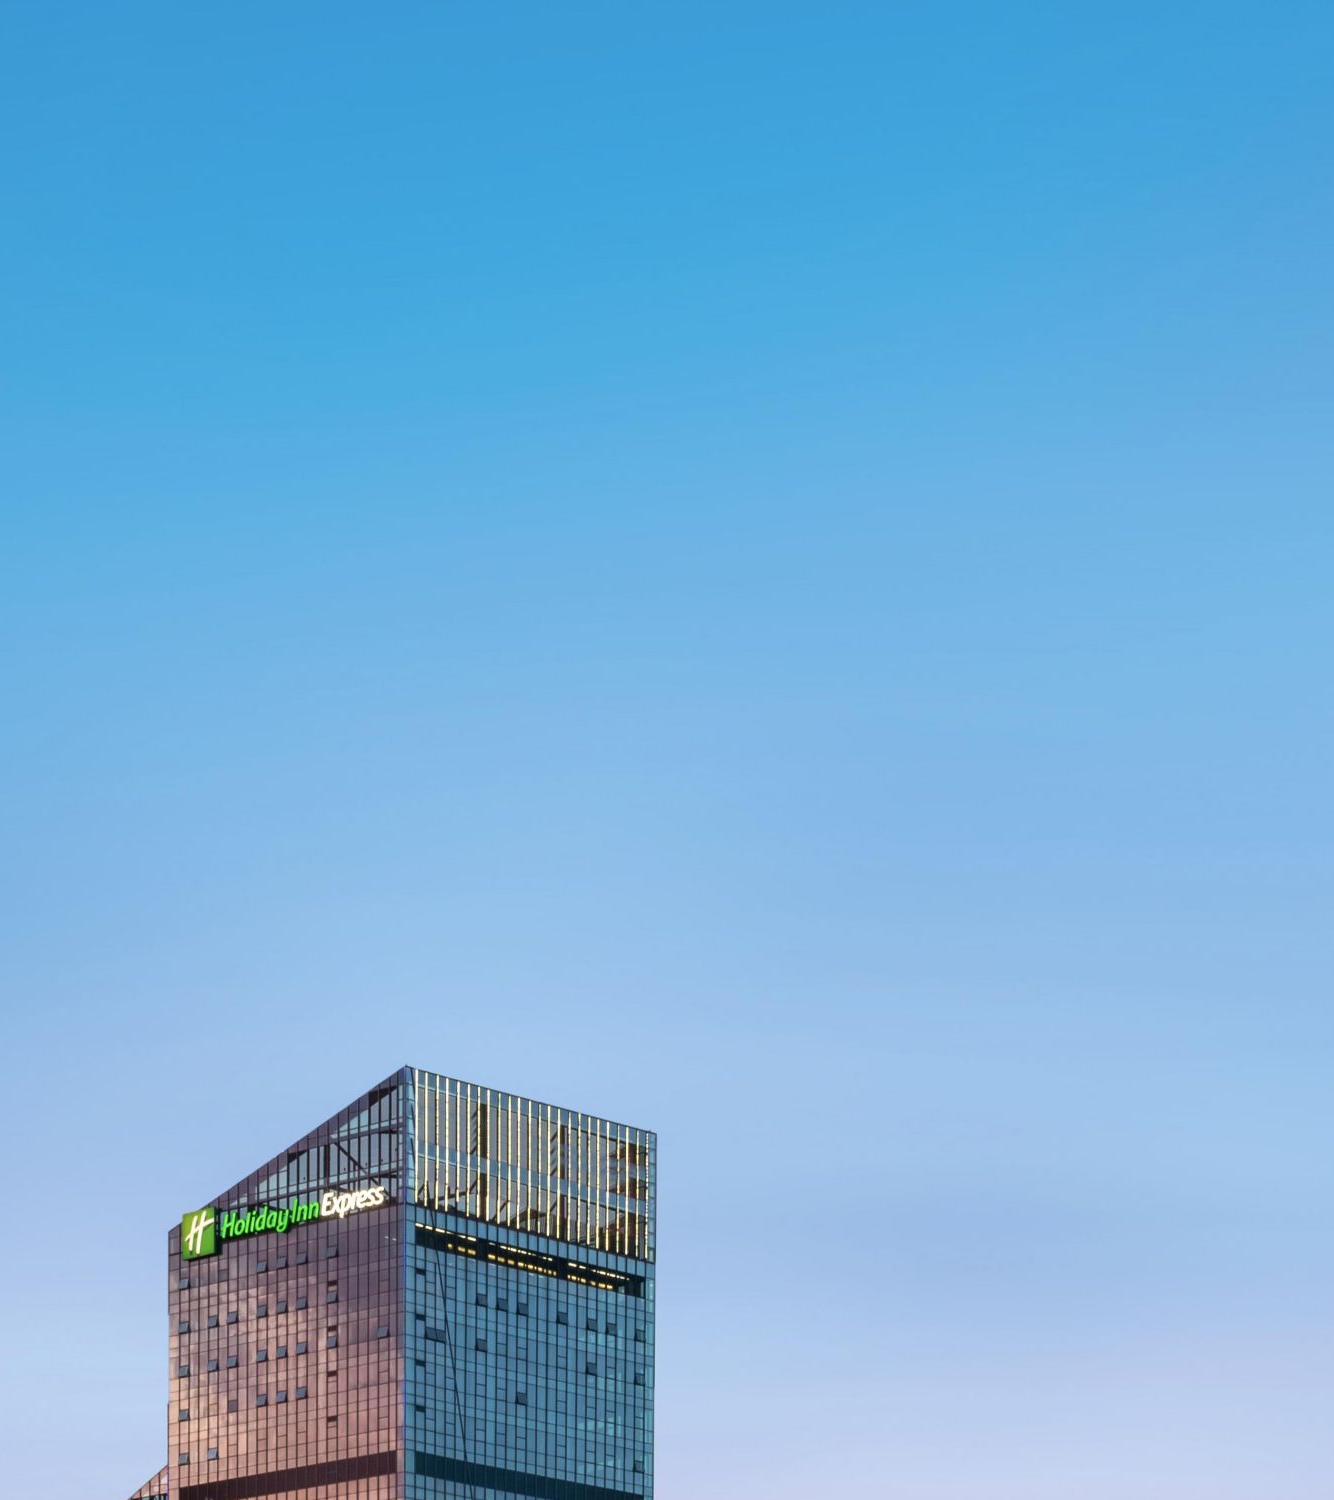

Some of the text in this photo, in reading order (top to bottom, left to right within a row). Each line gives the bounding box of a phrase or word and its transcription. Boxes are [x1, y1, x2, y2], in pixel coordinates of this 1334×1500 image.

[220, 1186, 385, 1239] Holiday Inn Express
